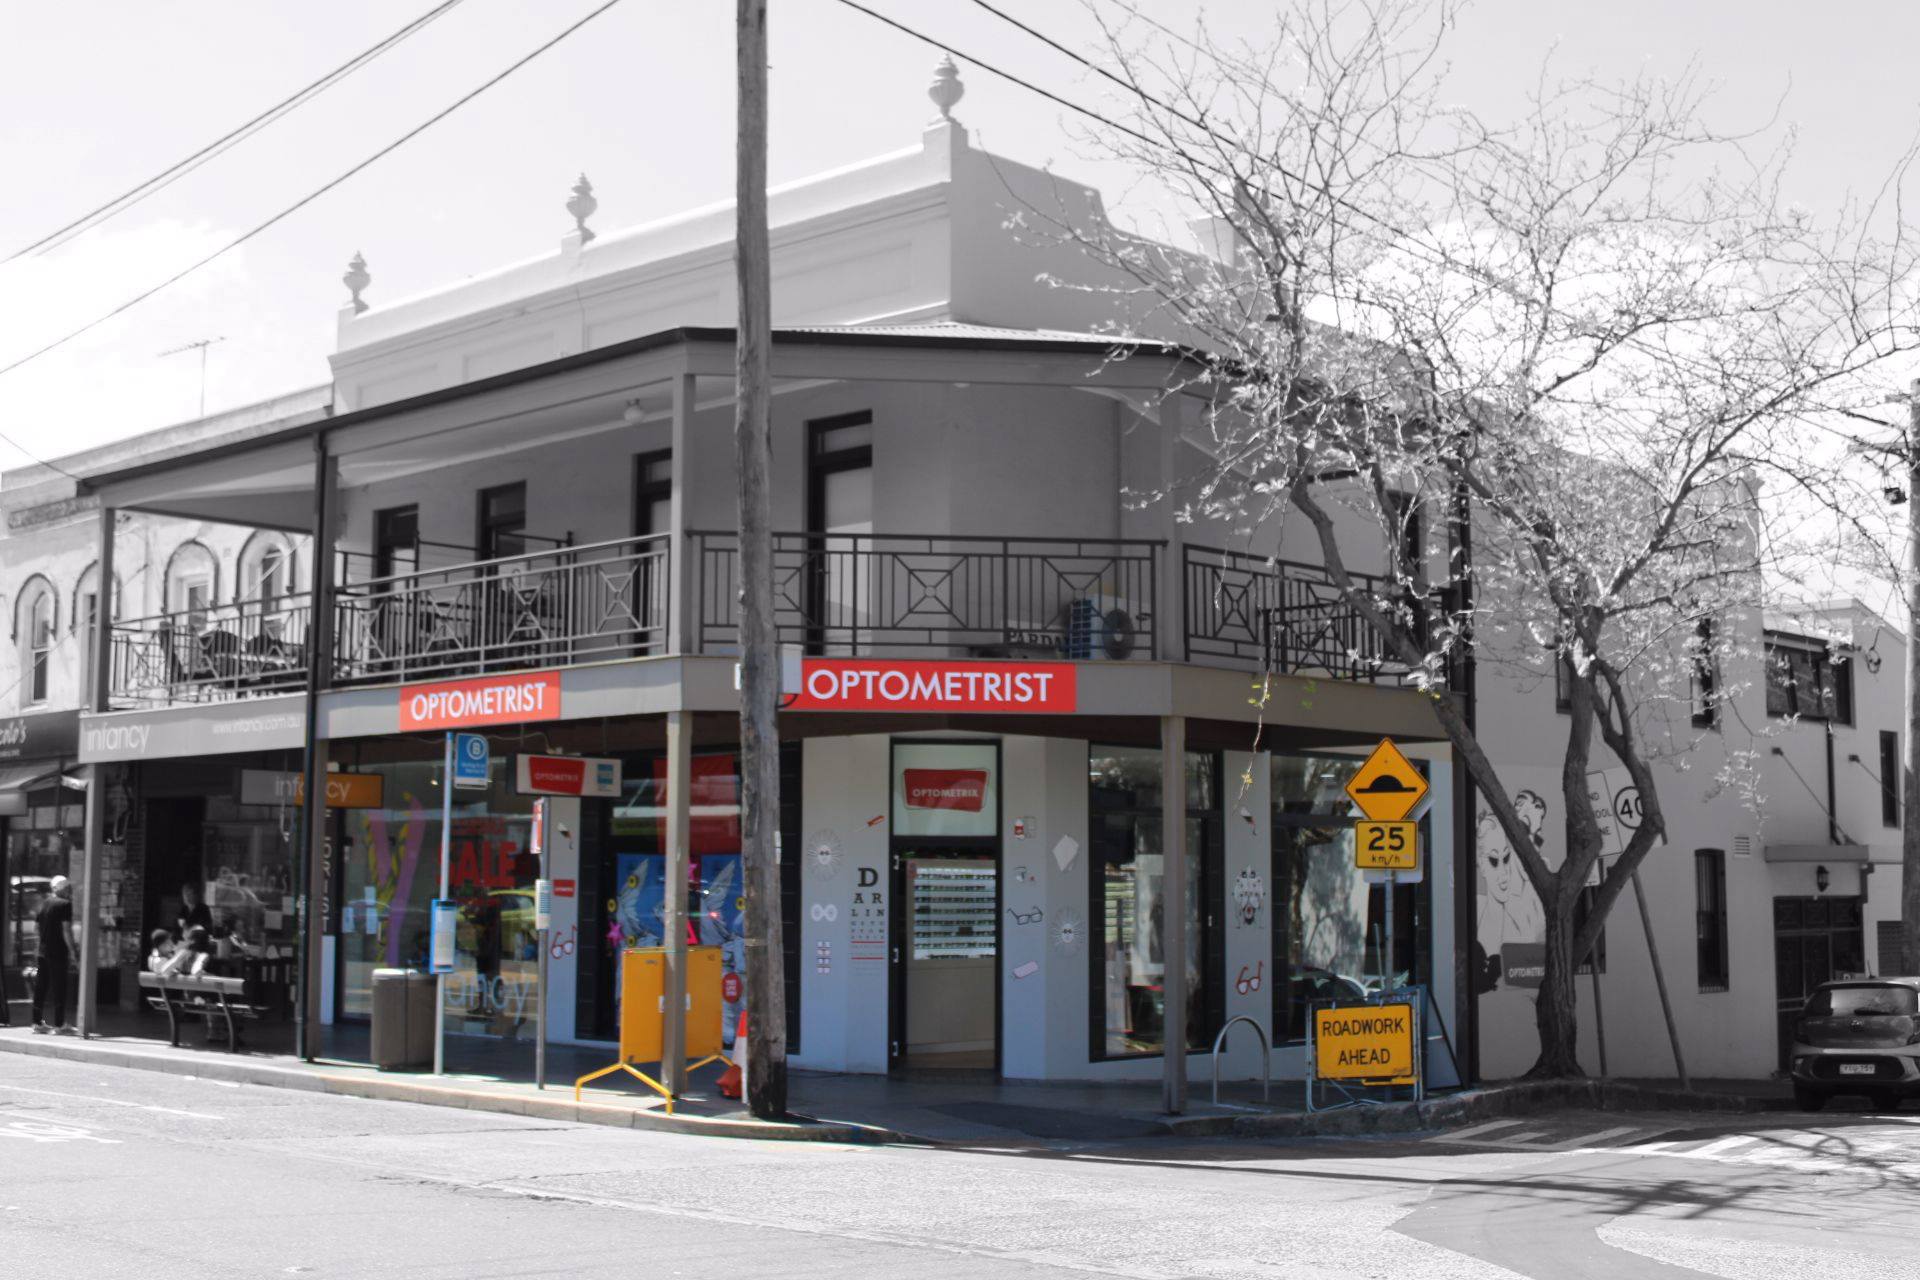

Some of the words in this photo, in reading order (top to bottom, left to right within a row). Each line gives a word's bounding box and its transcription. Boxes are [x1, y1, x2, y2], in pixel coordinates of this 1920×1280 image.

[805, 669, 1054, 702] OPTOMETRIST
[410, 682, 546, 721] OPTOMETRIST
[86, 720, 151, 753] infancy
[275, 776, 351, 802] infcy
[1368, 826, 1405, 851] 25
[1370, 854, 1401, 866] km/h
[857, 867, 879, 888] D
[1322, 1018, 1405, 1037] ROADWORK
[1338, 1048, 1391, 1066] AHEAD
